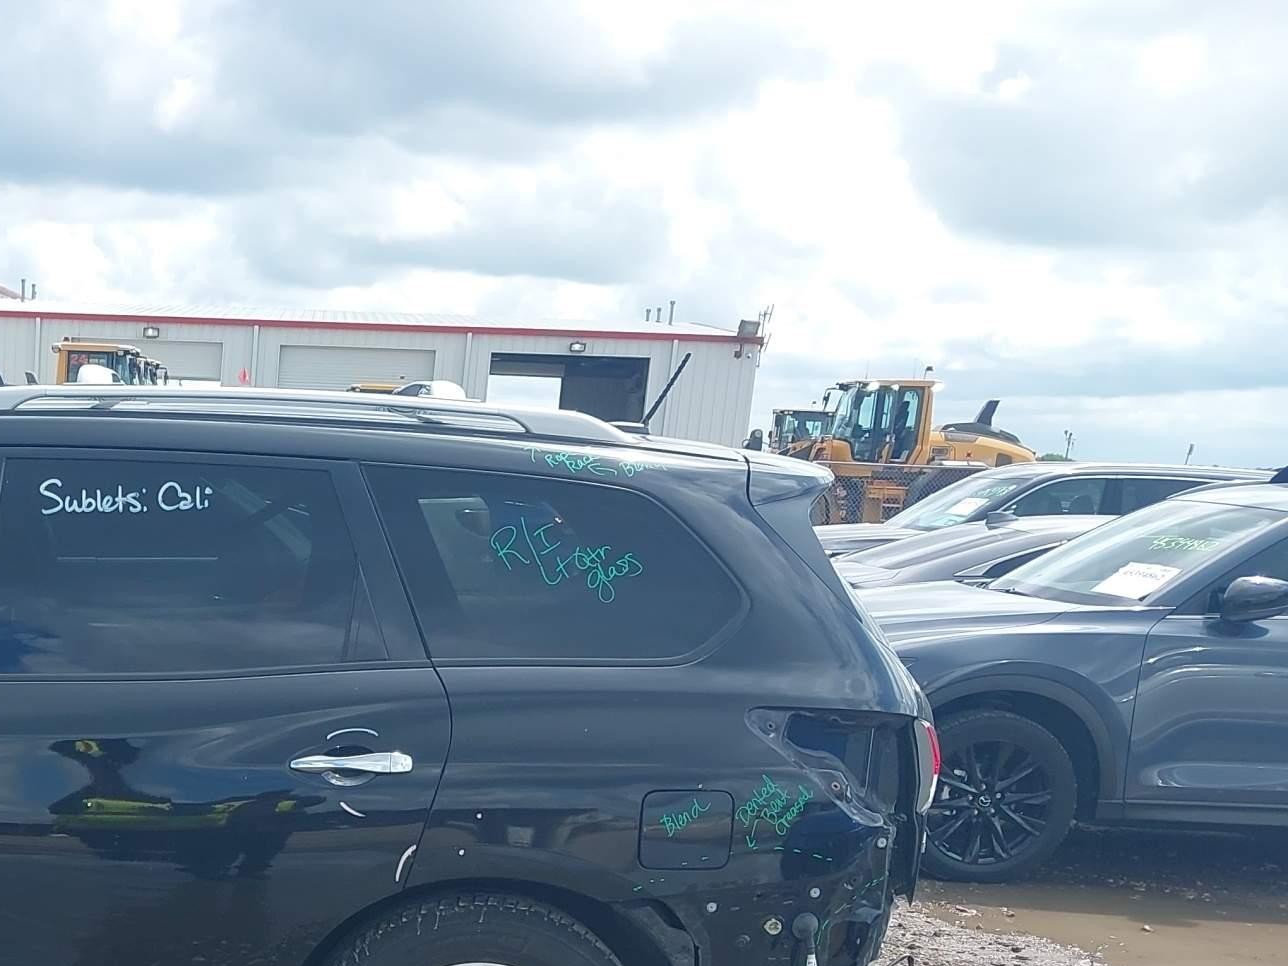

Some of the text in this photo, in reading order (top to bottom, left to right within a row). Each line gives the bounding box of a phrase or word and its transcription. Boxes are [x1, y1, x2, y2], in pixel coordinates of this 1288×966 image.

[39, 478, 213, 515] Sublets: Cali
[660, 798, 711, 838] Blend
